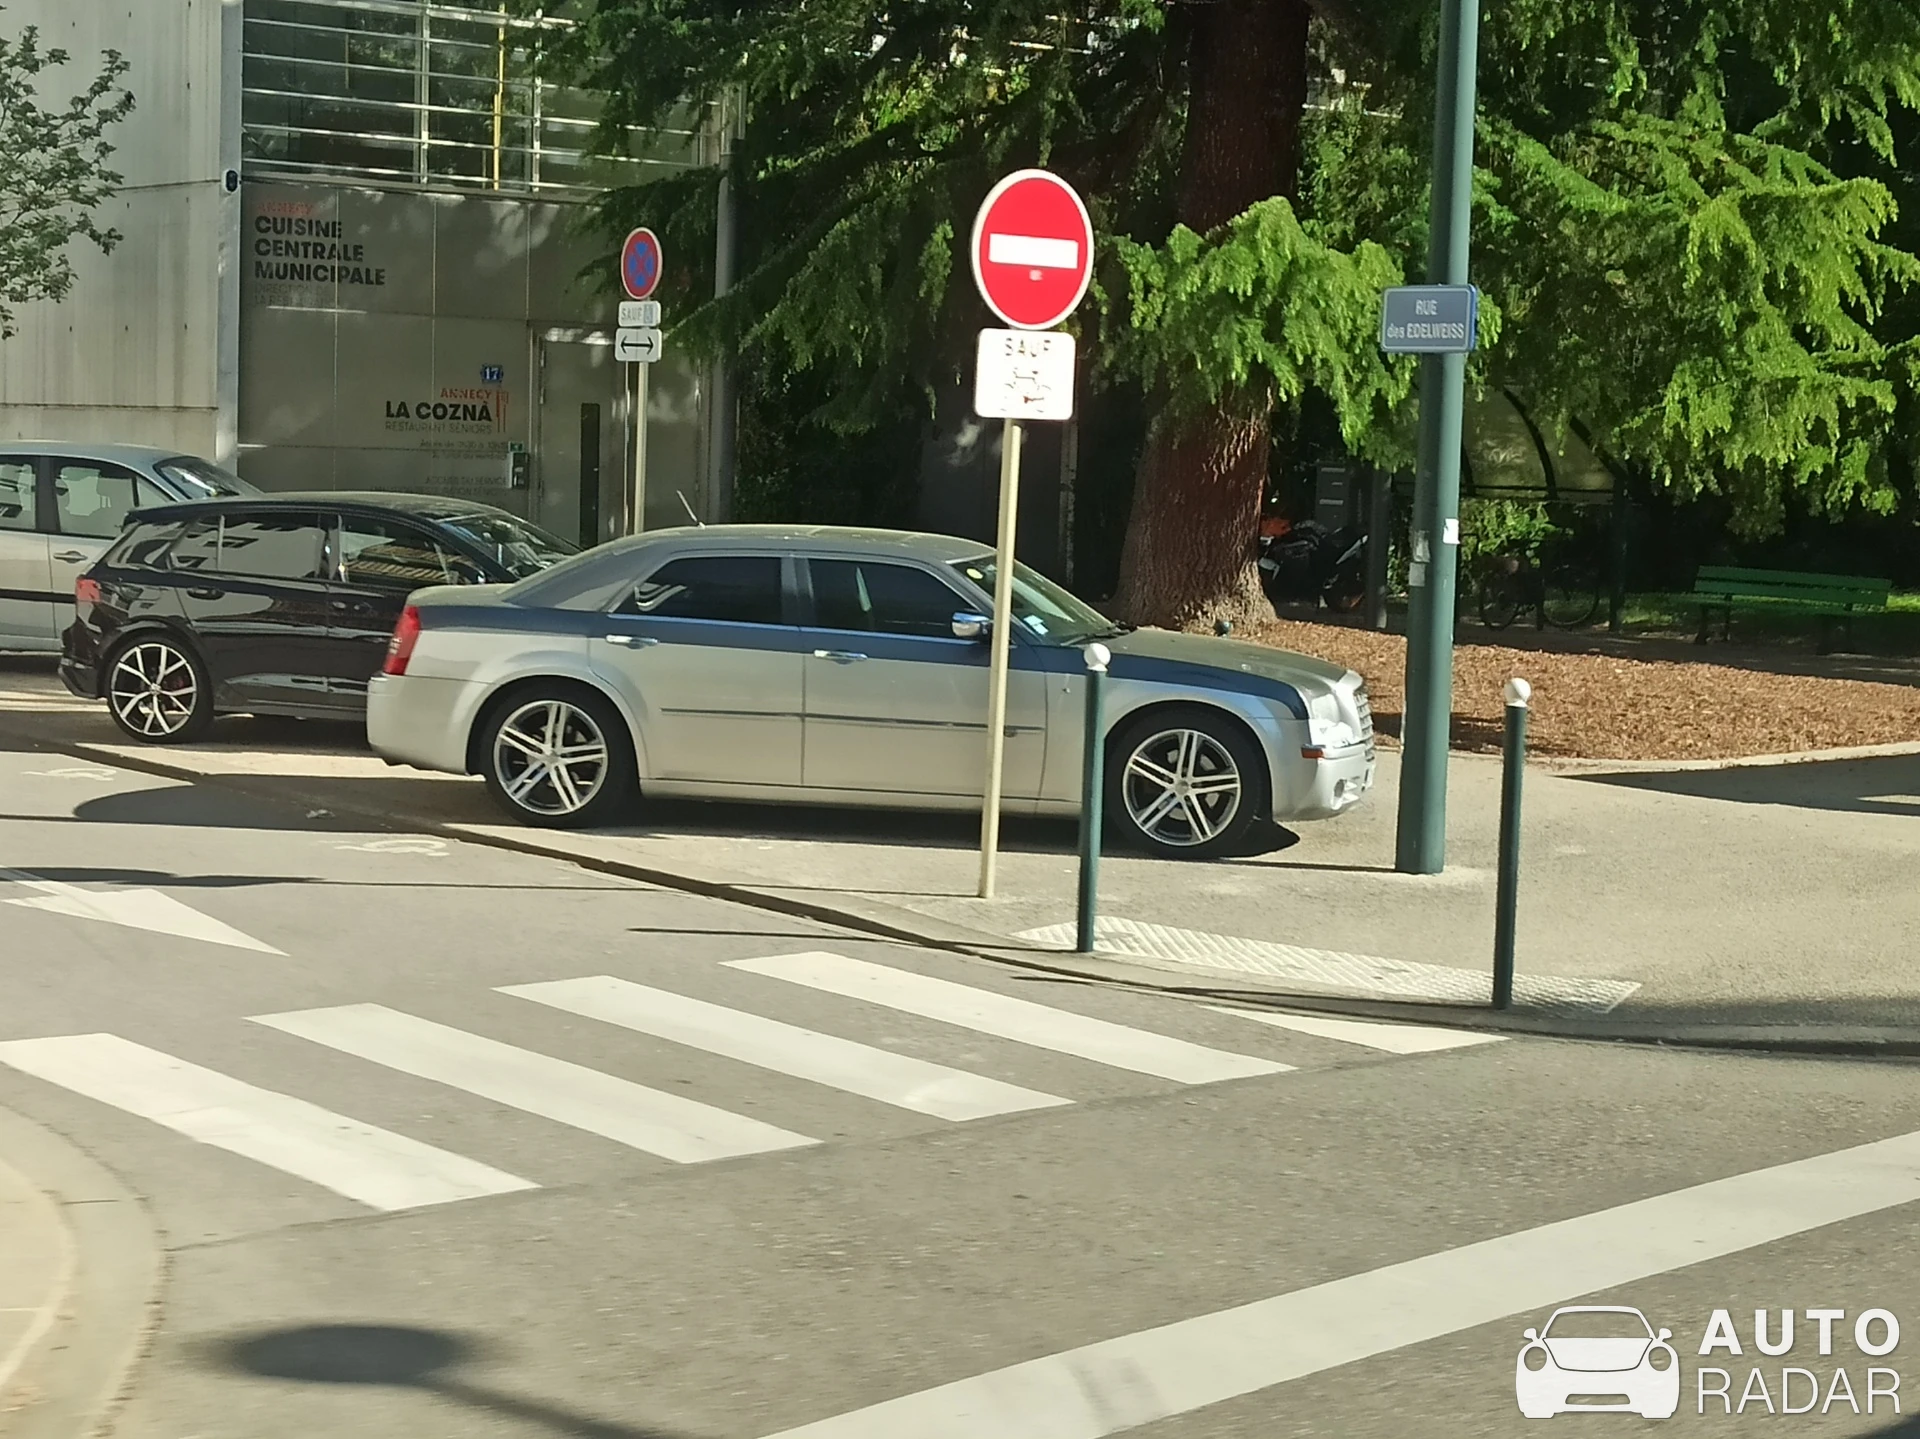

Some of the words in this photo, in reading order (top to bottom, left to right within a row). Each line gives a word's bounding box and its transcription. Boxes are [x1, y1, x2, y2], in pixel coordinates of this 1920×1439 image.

[254, 215, 342, 239] CUISINE
[254, 238, 364, 262] CENTRALE
[254, 261, 386, 286] MUNICIPALE
[621, 306, 643, 321] SAUF
[1415, 299, 1439, 315] RUE
[1386, 322, 1405, 338] des
[1406, 322, 1465, 338] EDELWEISS
[485, 367, 499, 380] 17
[440, 387, 492, 400] ANNECY
[386, 400, 410, 418] LA
[385, 420, 446, 434] RESTAURANT
